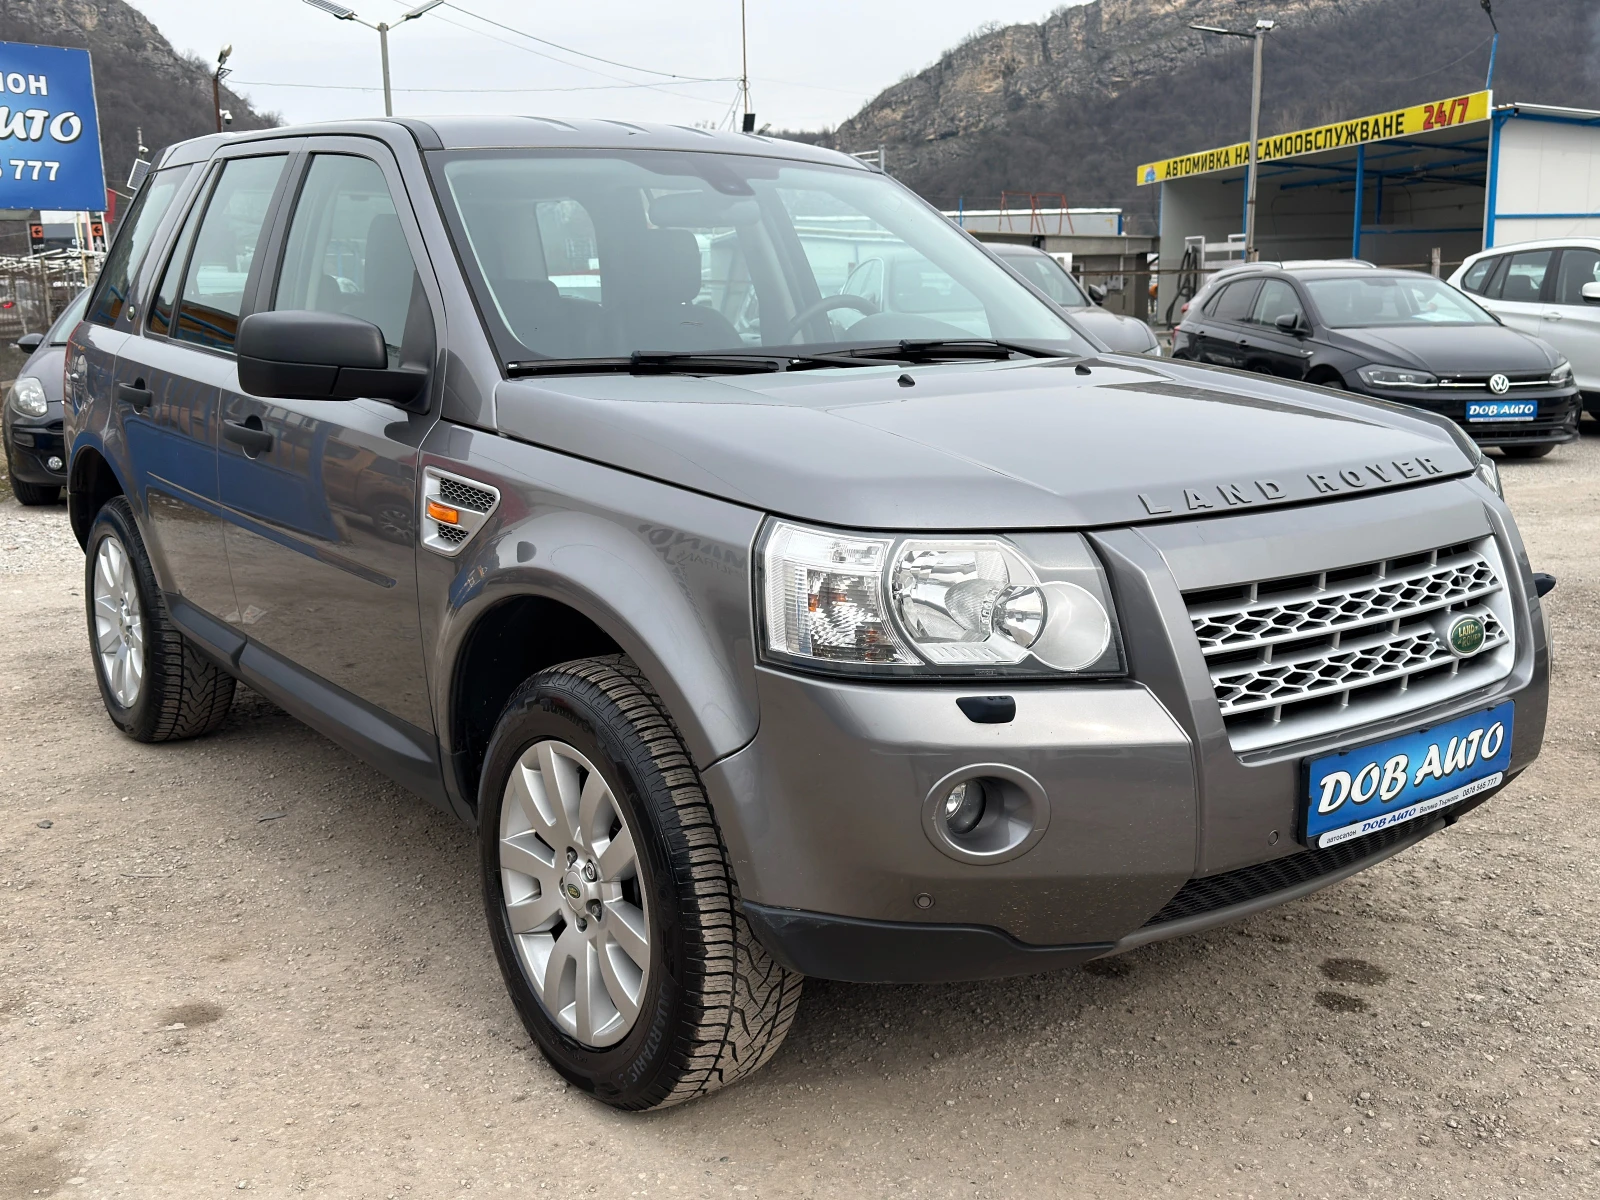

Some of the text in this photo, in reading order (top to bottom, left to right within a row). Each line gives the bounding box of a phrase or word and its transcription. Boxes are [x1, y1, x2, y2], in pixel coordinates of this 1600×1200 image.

[0, 72, 48, 96] ОН
[1165, 97, 1469, 179] АВТОМИВКА НА САМООБСЛУЖВАНЕ 24/7
[9, 159, 60, 181] 777
[1469, 404, 1534, 416] DOB AUTO
[1138, 457, 1443, 515] LAND ROVER
[1458, 624, 1475, 638] LAND
[1318, 721, 1504, 814] DOB AUTO
[1326, 829, 1357, 844] автосалон
[1362, 816, 1387, 832] DOB
[1388, 807, 1417, 824] AUTO
